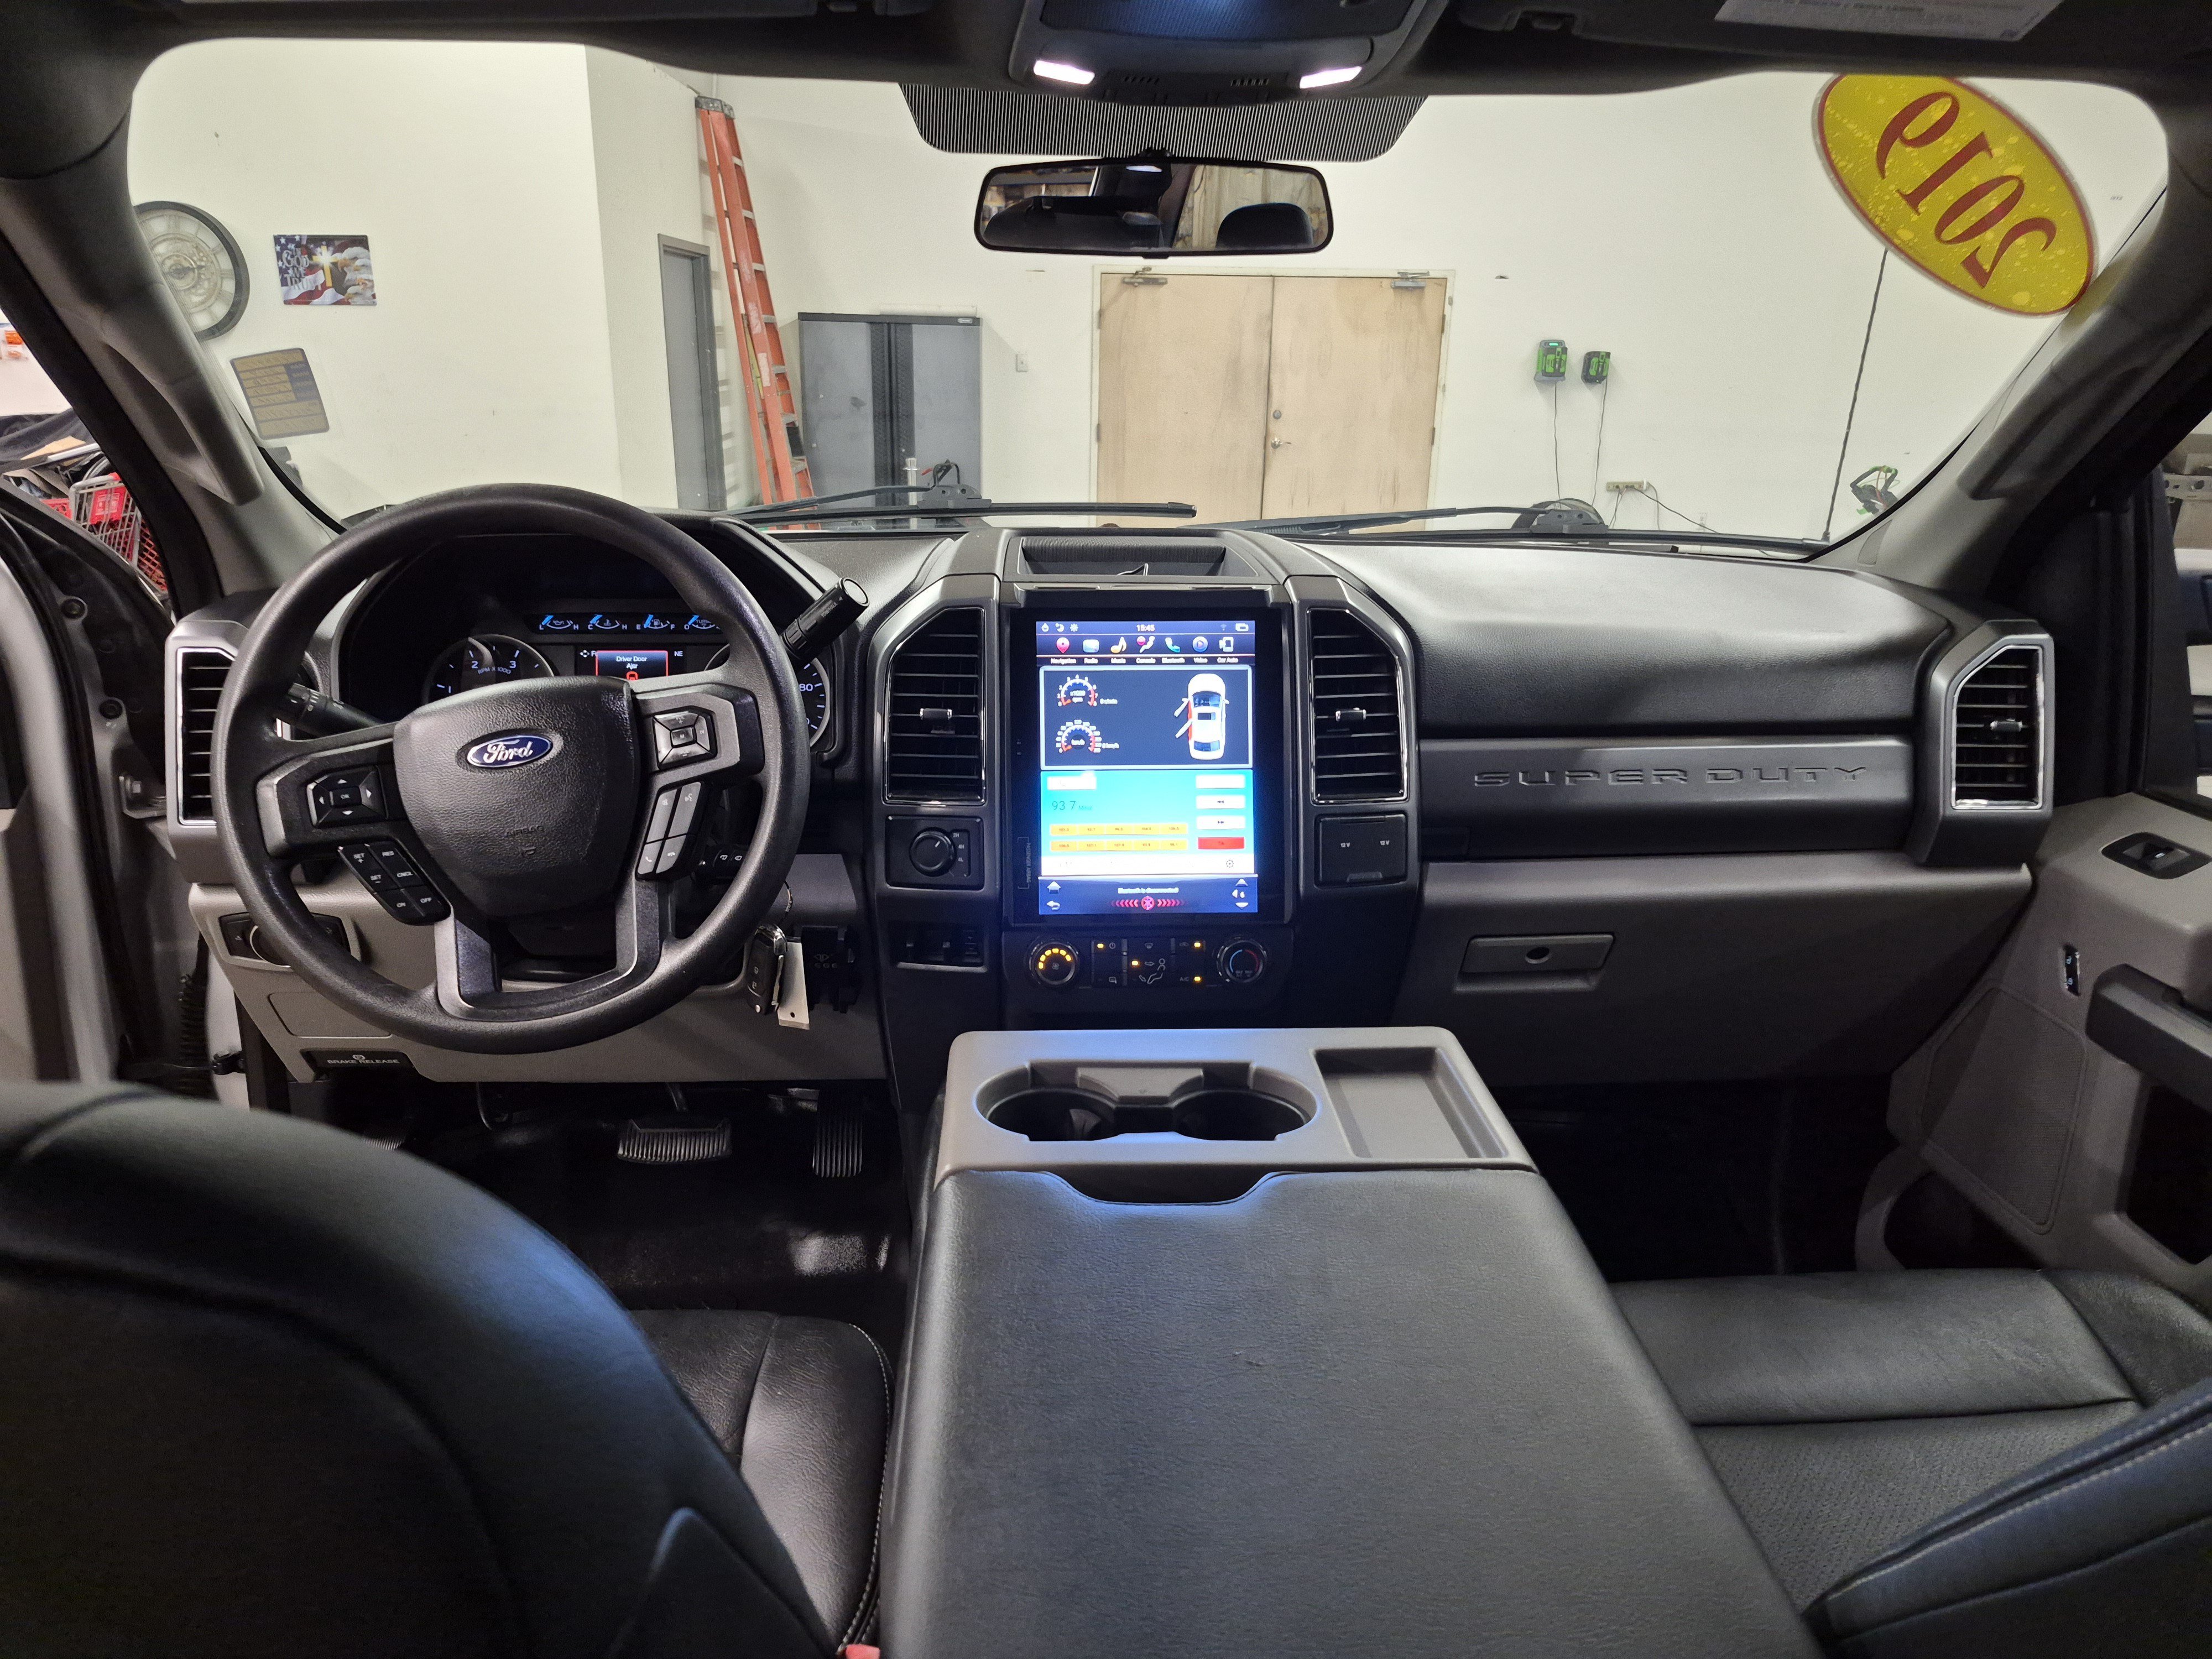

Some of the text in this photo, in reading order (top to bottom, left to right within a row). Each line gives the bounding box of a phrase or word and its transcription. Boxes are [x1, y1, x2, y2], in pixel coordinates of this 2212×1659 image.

[283, 249, 310, 268] GOD
[471, 660, 478, 669] 2
[509, 660, 517, 669] 3
[477, 666, 491, 675] RPM
[497, 666, 511, 675] 1000
[799, 683, 813, 692] 80
[483, 739, 533, 764] Ford
[1474, 766, 1867, 787] SUPER DUTY
